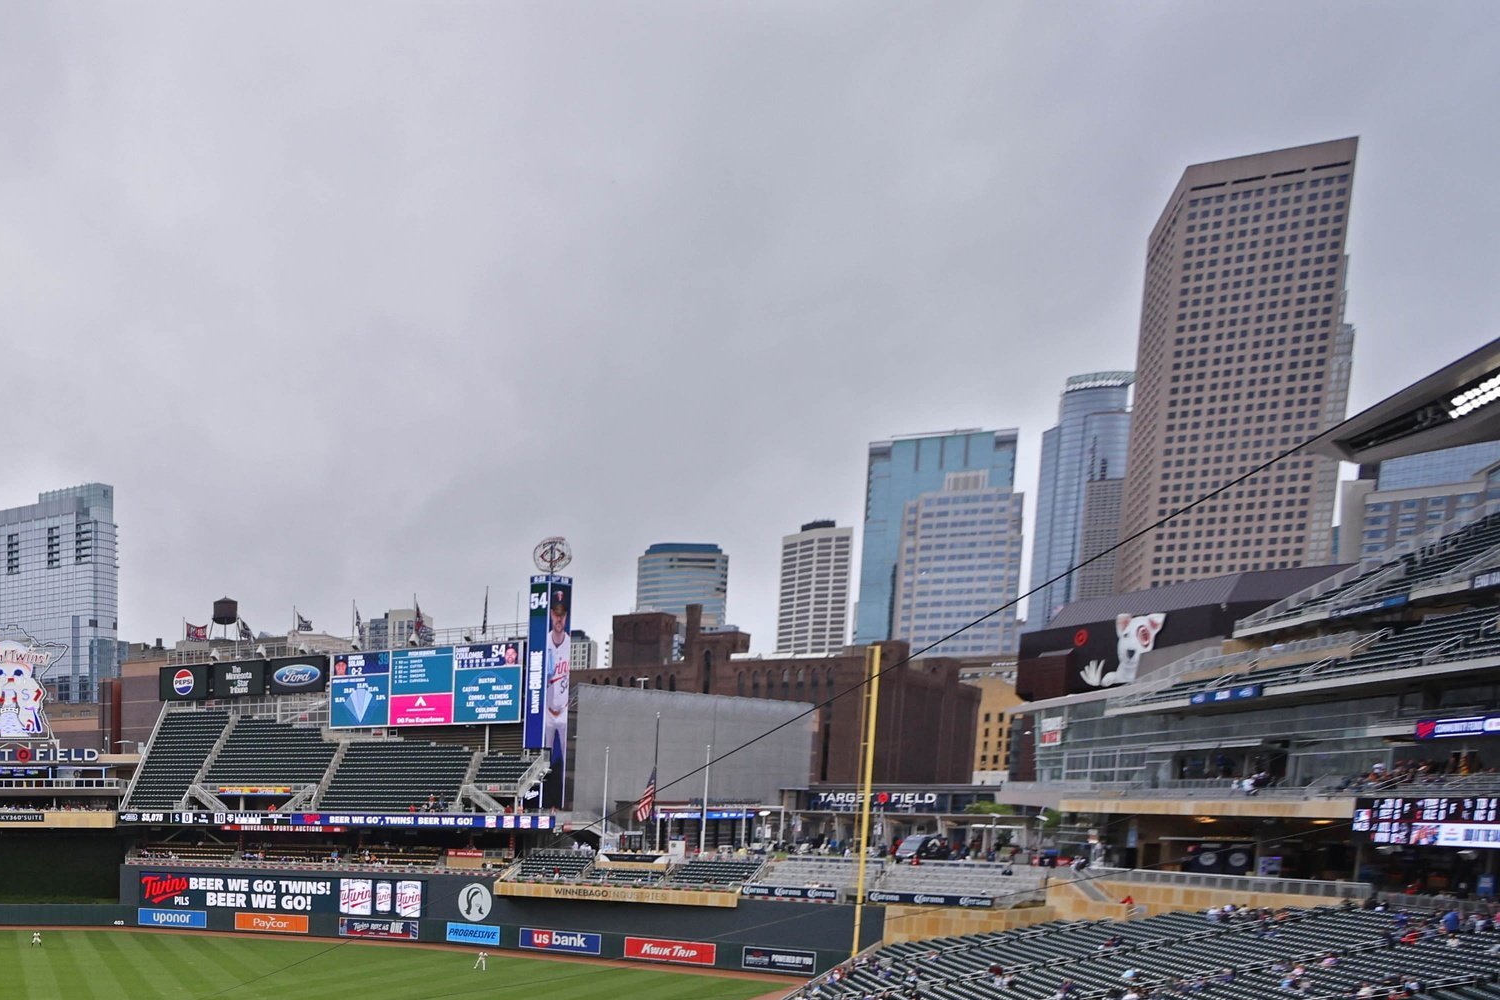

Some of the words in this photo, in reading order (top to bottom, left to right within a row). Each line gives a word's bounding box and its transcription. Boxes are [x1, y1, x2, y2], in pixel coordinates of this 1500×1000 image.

[530, 592, 547, 610] 54
[9, 650, 50, 665] Twins!
[456, 651, 484, 660] COULOMBE
[491, 645, 505, 658] 54
[226, 672, 252, 680] Minnesota
[282, 670, 311, 682] Ford
[529, 651, 543, 689] COULOMBE
[530, 691, 539, 714] DANNY
[36, 749, 99, 761] FIELD
[890, 793, 937, 804] FIELD
[141, 813, 163, 822] $5,075
[215, 814, 224, 823] 10
[329, 816, 350, 824] BEER
[351, 816, 364, 824] WE
[385, 816, 414, 825] TWINS!
[418, 817, 440, 825] BEER
[441, 817, 455, 825] WE
[456, 817, 473, 826] GO!
[141, 874, 188, 904] Twins
[189, 877, 225, 891] BEER
[227, 879, 249, 892] WE
[279, 881, 331, 895] TWINS!
[743, 885, 769, 895] Corona
[807, 889, 836, 899] Corona
[554, 887, 608, 898] WINNEBAGO
[608, 891, 667, 901] INDUSTRIES
[870, 891, 899, 902] Corona
[913, 894, 944, 904] Corona
[174, 896, 190, 906] PILS
[206, 892, 247, 907] BEER
[251, 894, 276, 909] WE
[282, 895, 312, 910] GO!
[152, 912, 191, 924] uponor
[253, 916, 289, 930] Paycor
[448, 927, 499, 941] PROGRESSIVE
[533, 930, 550, 945] us
[552, 932, 587, 948] bank
[770, 954, 794, 964] POWERED
[795, 956, 802, 965] BY
[803, 956, 813, 966] YOU
